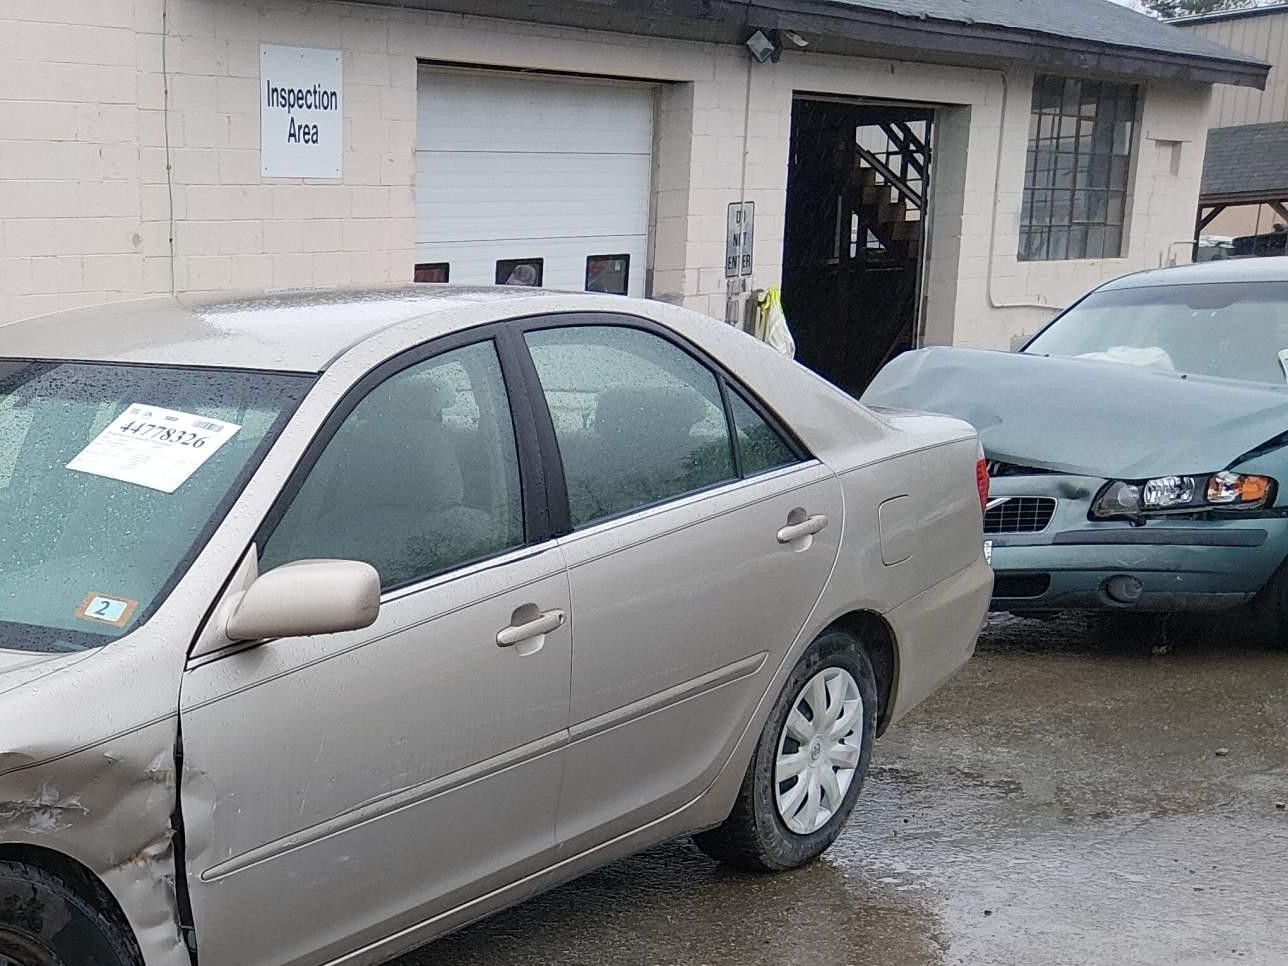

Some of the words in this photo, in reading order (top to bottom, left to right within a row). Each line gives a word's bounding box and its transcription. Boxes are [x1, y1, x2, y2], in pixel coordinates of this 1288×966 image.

[266, 79, 338, 114] Inspection
[287, 116, 319, 145] Area
[119, 420, 210, 449] 44778326
[93, 600, 111, 616] 2
